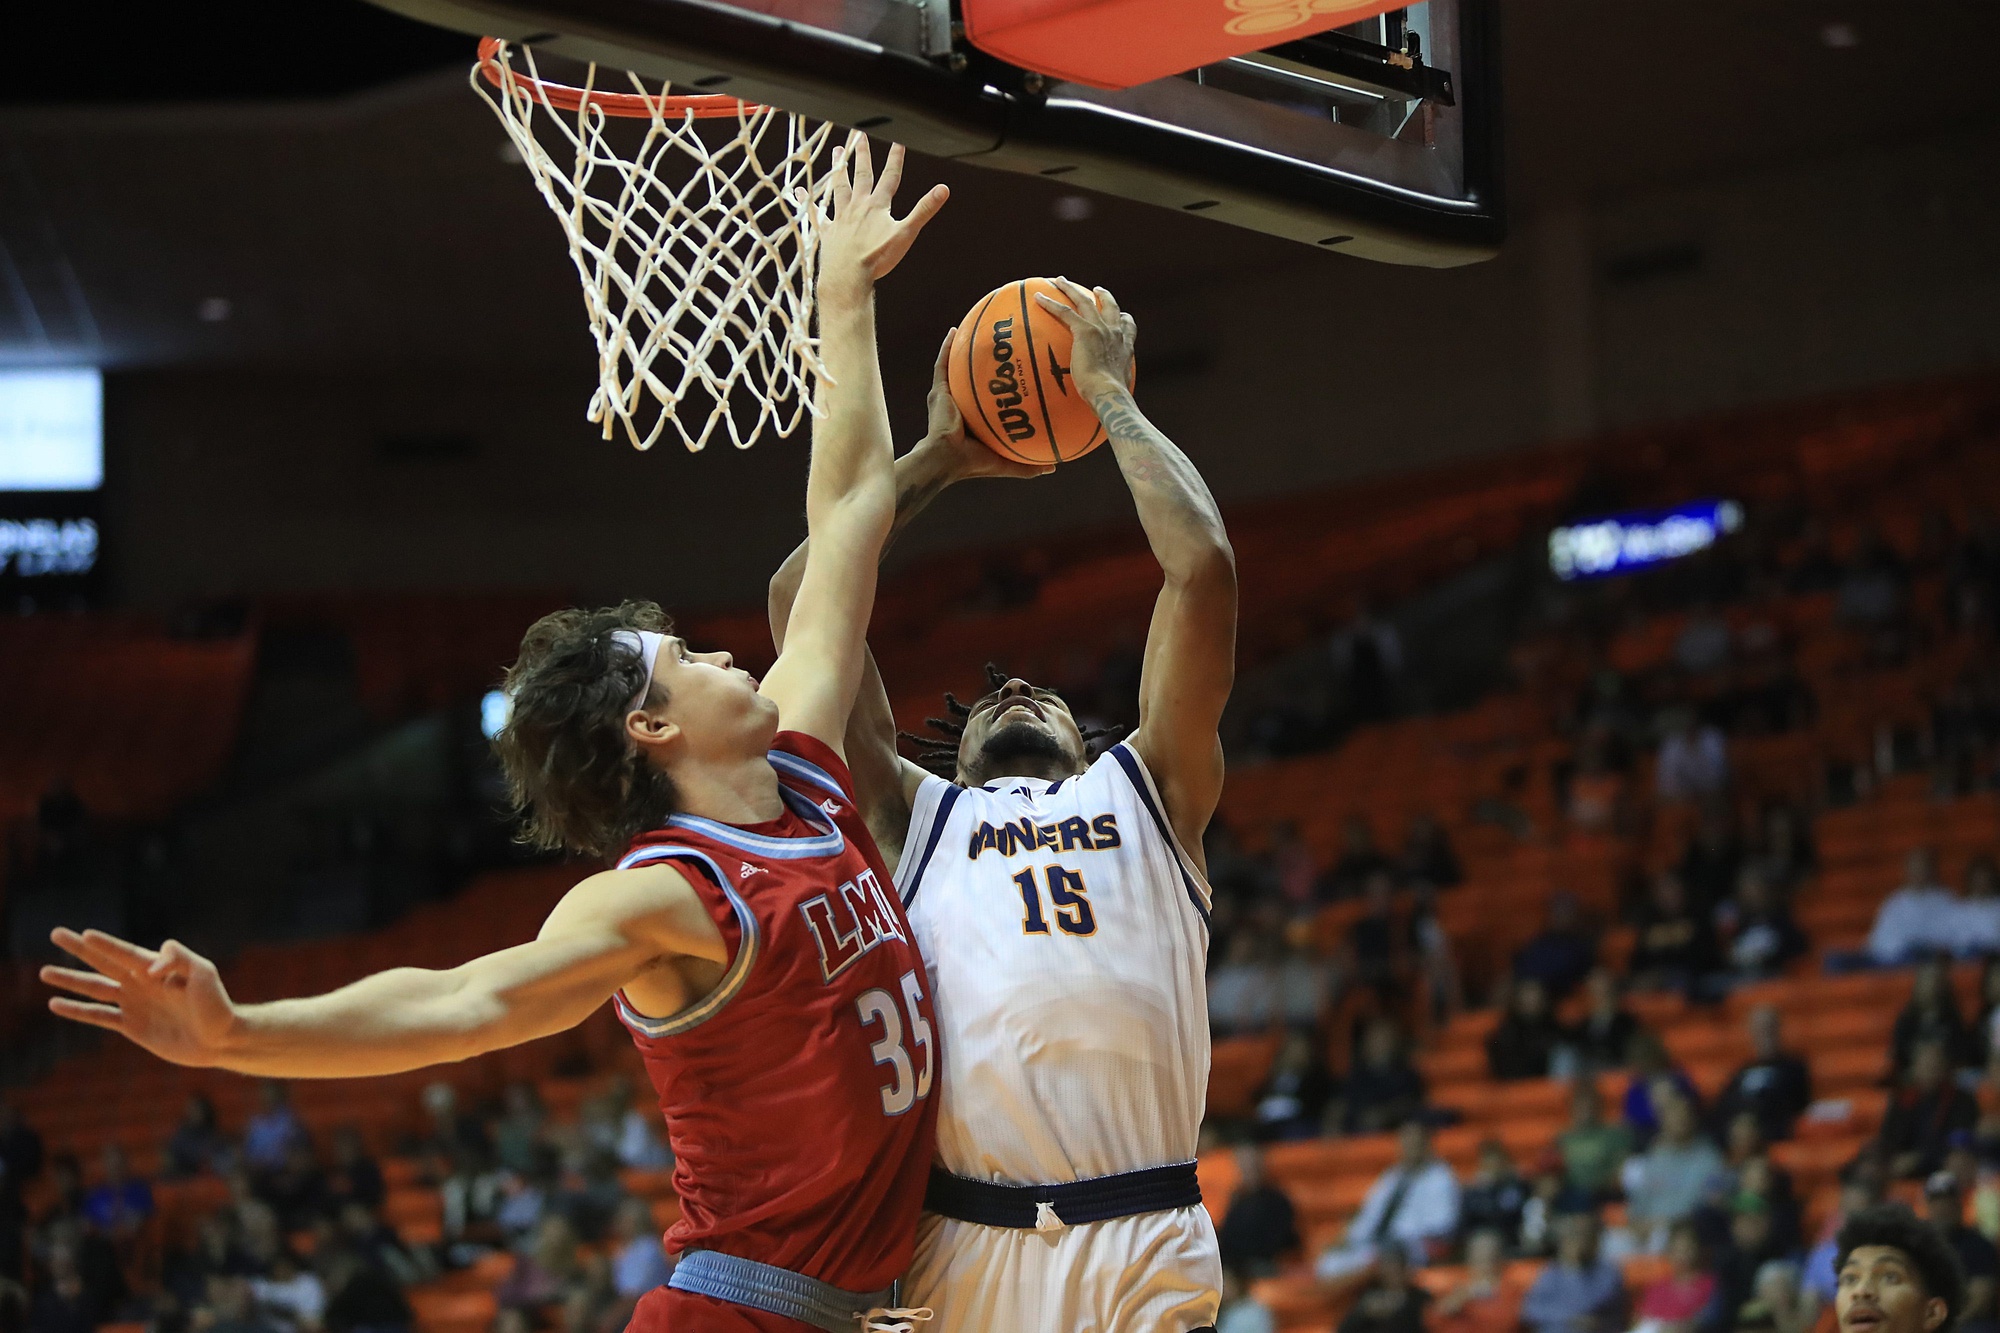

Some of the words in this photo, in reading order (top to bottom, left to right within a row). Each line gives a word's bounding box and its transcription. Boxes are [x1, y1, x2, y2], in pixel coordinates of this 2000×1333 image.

[988, 317, 1036, 444] Wilson
[1016, 358, 1024, 377] NXT
[1020, 378, 1029, 397] EVO
[968, 812, 1122, 860] MINERS
[1011, 863, 1098, 937] 15
[855, 969, 934, 1116] 35
